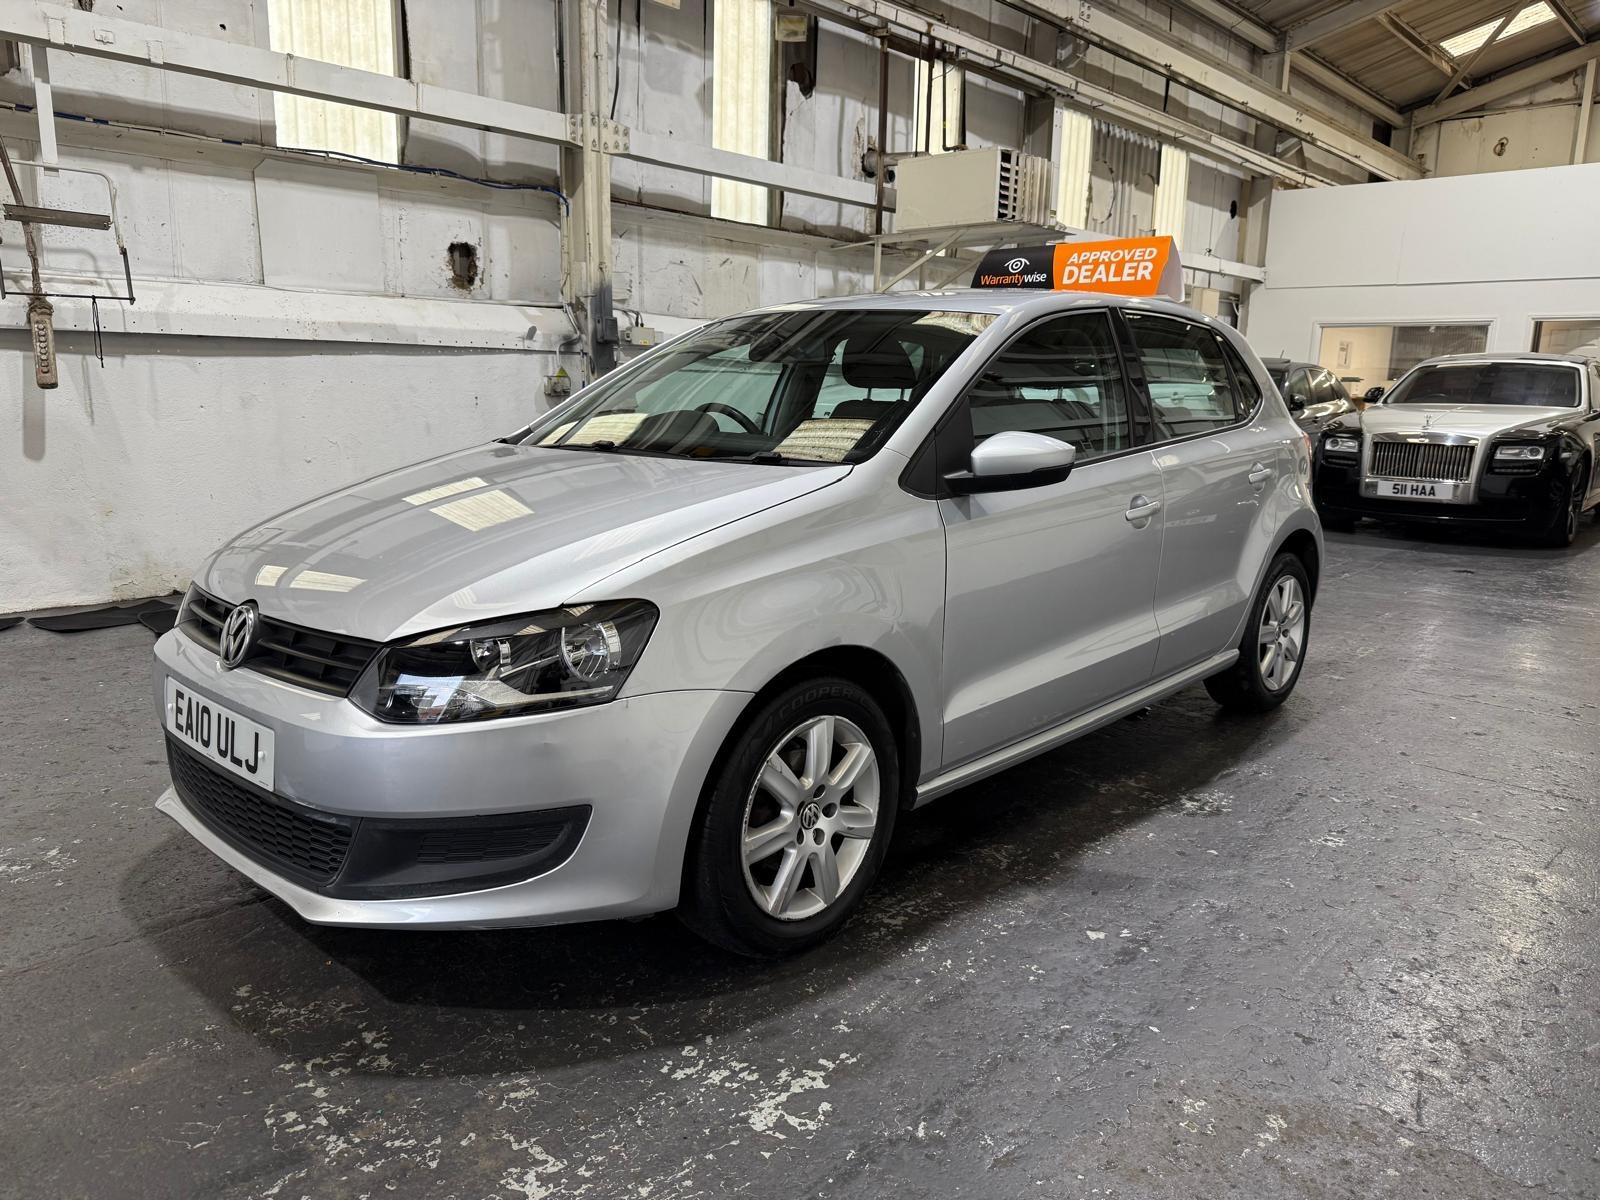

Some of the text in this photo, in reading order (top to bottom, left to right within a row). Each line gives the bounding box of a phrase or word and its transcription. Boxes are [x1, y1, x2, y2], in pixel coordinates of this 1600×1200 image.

[1067, 247, 1158, 265] APPROVED
[980, 271, 1047, 287] Warrantywise
[1062, 262, 1154, 285] DEALER
[1410, 484, 1436, 497] HAA
[779, 686, 854, 720] COOPER
[175, 689, 259, 775] EA10 ULJ
